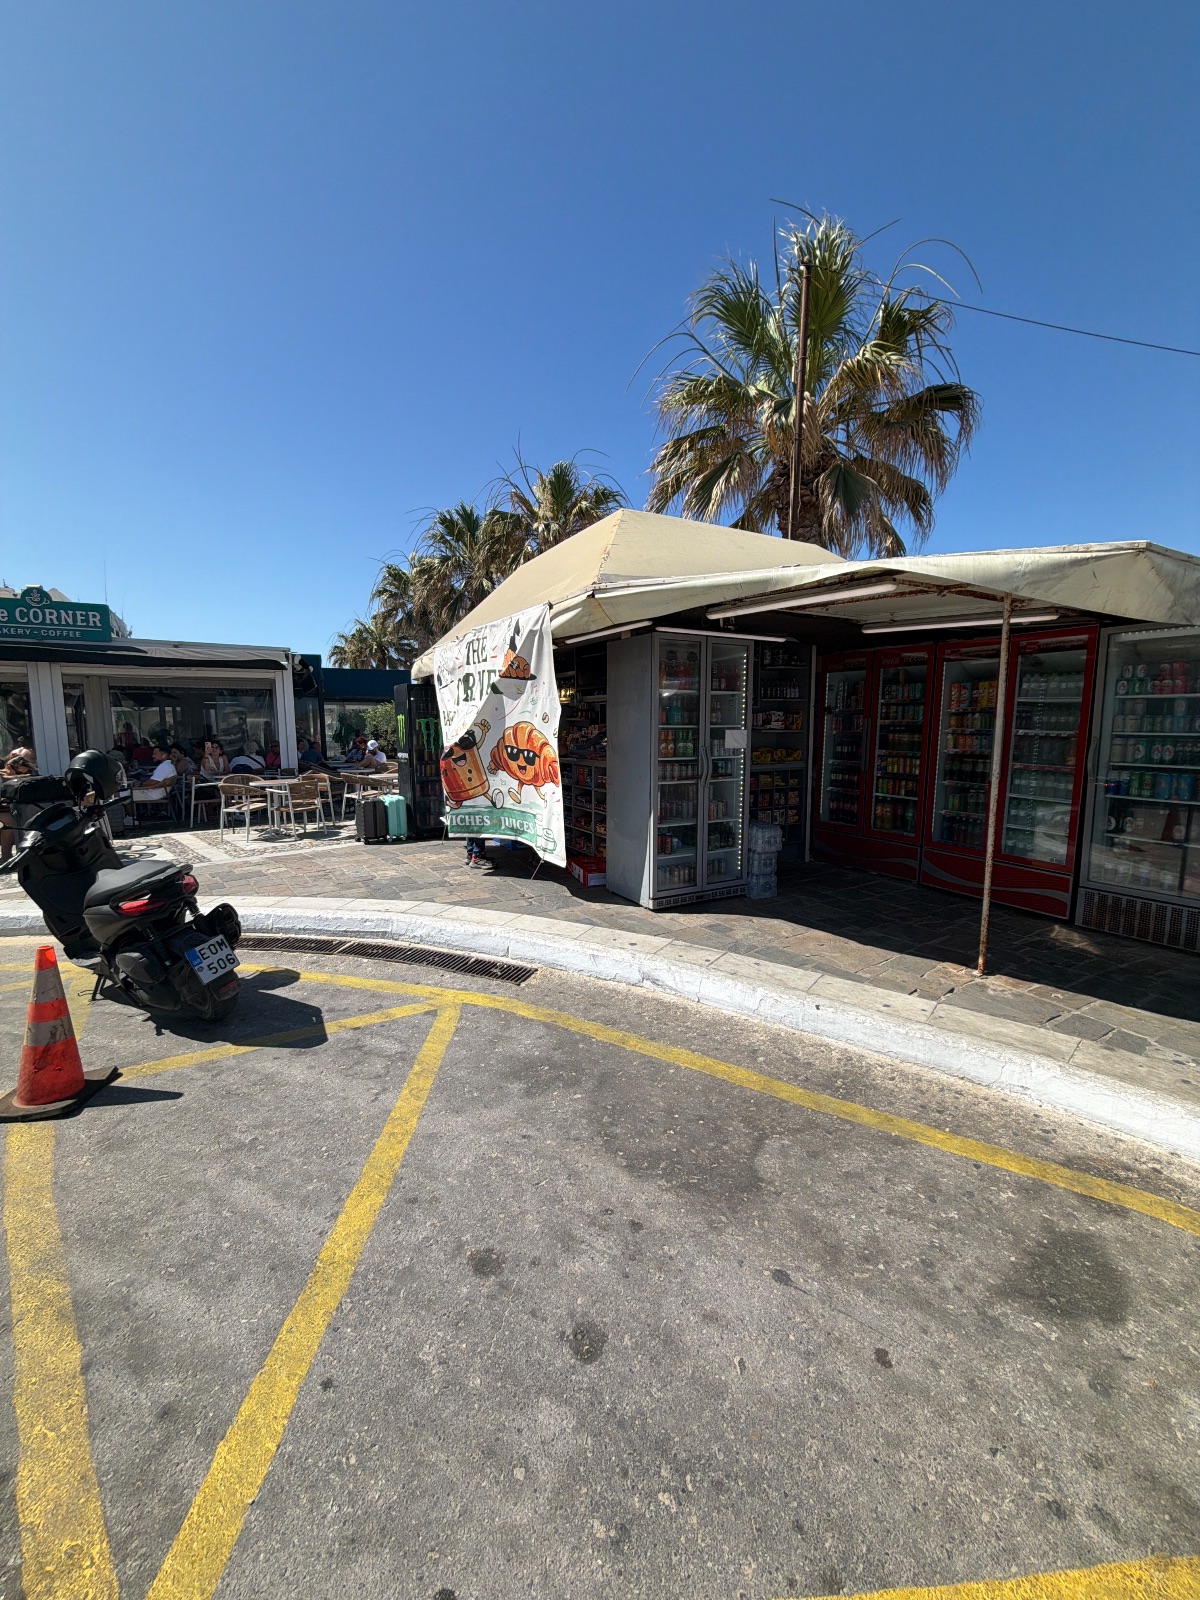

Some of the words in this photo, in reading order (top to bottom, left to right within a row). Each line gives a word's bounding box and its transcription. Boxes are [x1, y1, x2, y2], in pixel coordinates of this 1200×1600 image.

[15, 607, 102, 627] CORNER
[0, 627, 31, 635] KERY
[41, 629, 82, 638] COFFEE
[466, 636, 488, 666] THE
[500, 816, 535, 835] JUICES
[198, 939, 228, 960] EOM
[207, 954, 235, 974] 506
